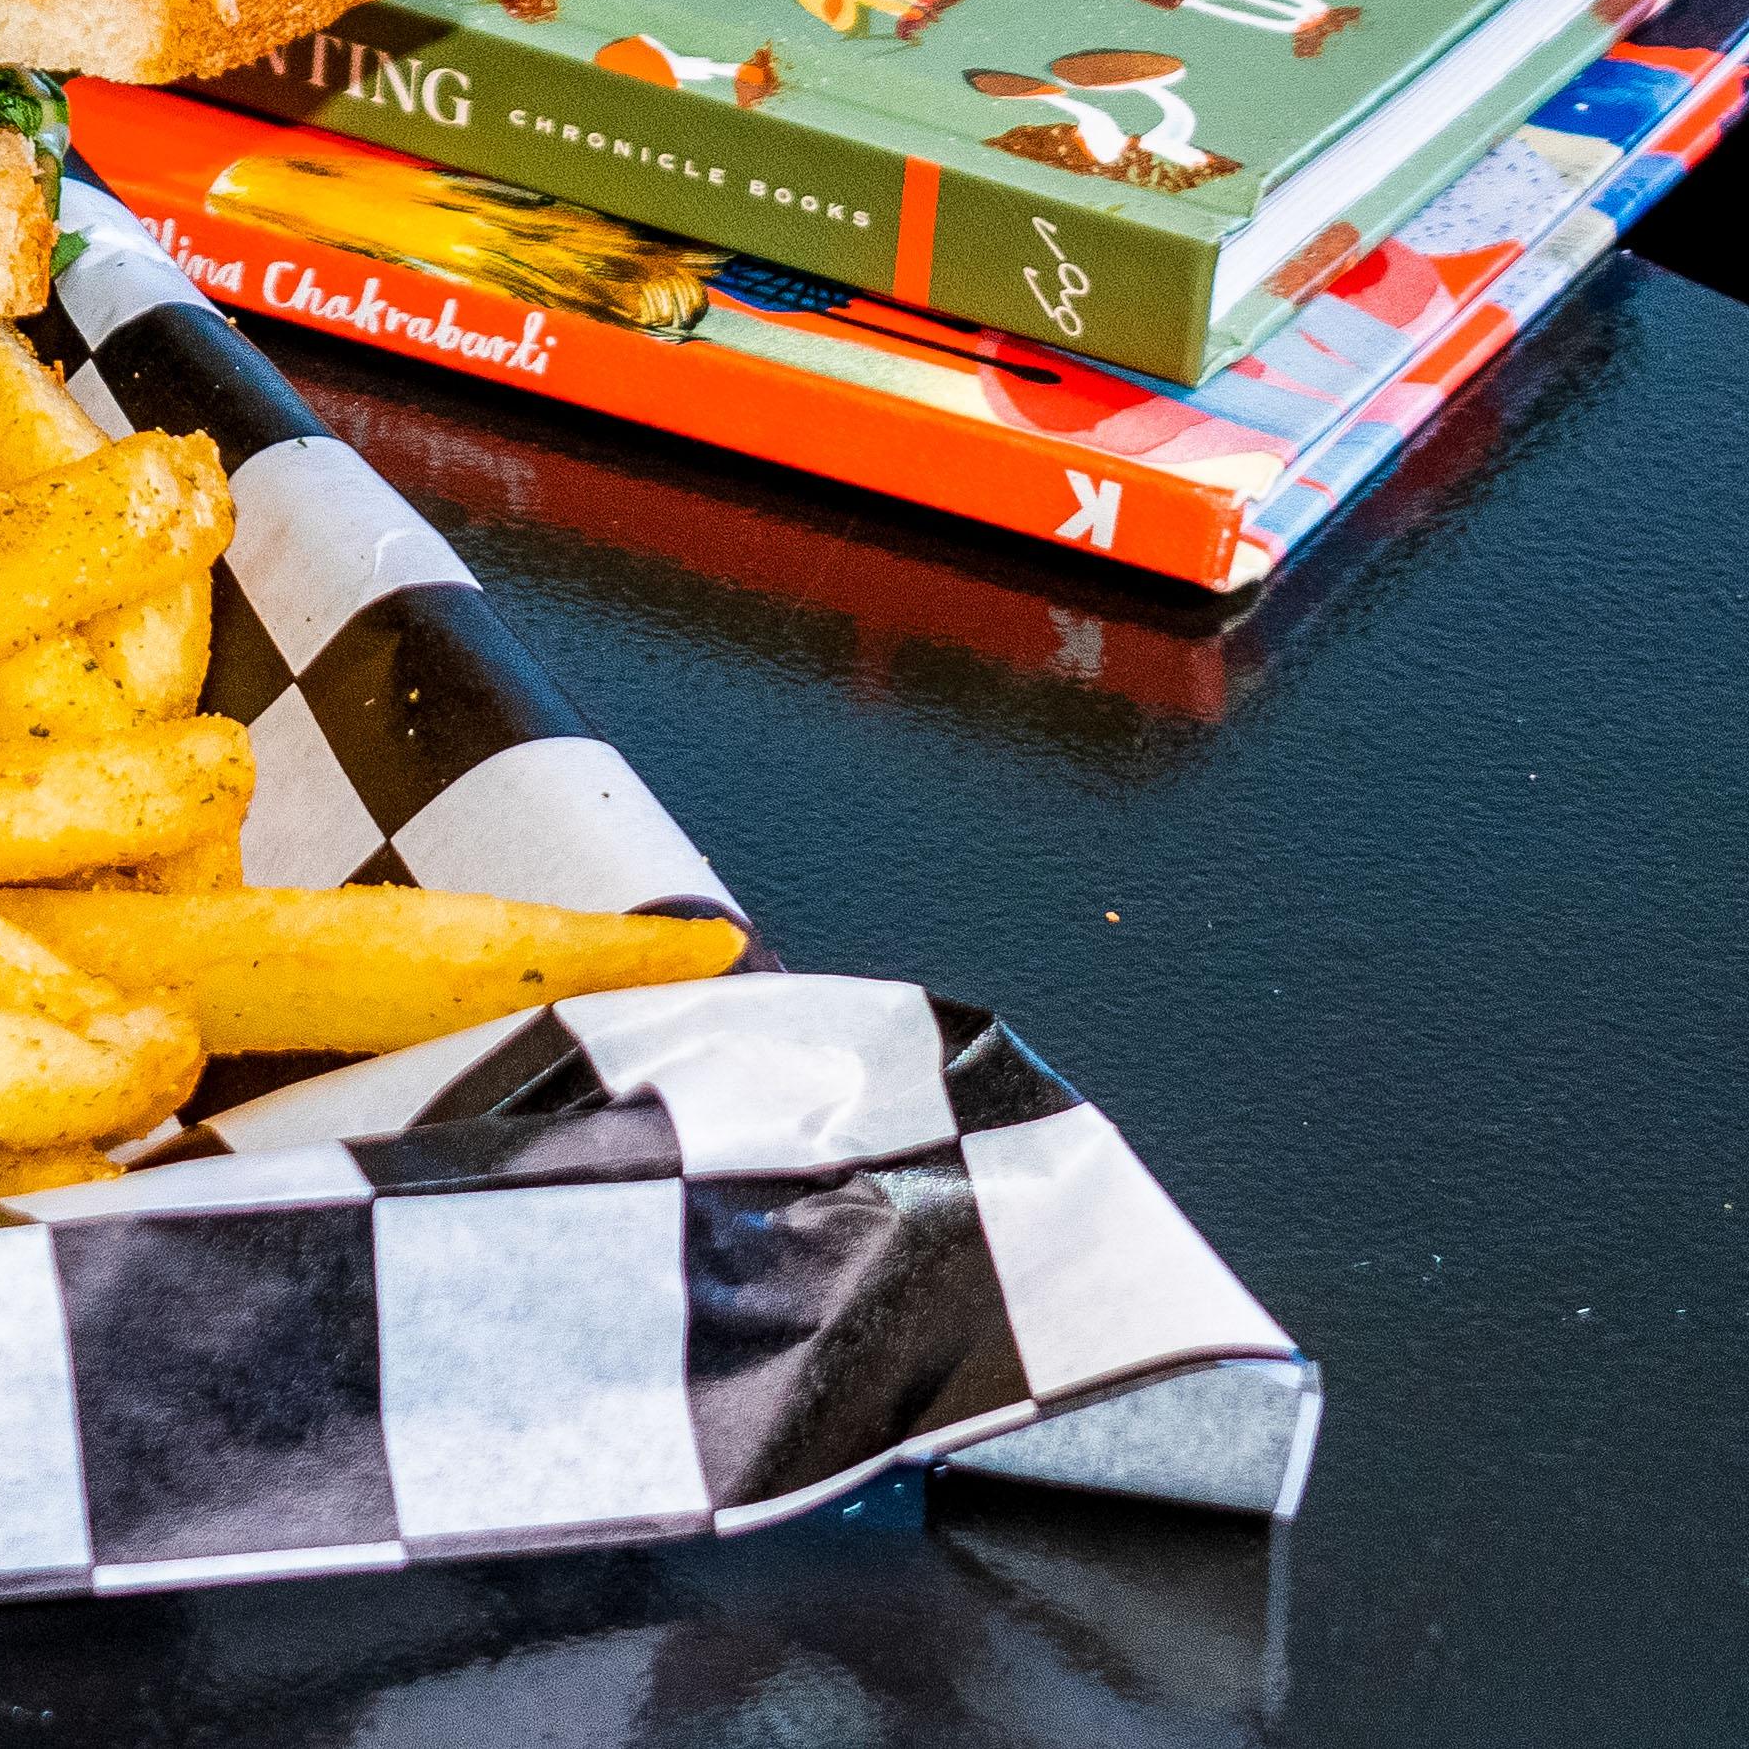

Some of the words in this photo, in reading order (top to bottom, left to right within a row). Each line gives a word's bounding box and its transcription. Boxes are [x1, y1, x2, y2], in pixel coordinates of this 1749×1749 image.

[508, 108, 728, 187] CHRONICLE
[748, 178, 871, 229] BOOKS
[262, 259, 559, 377] Chakrabarti
